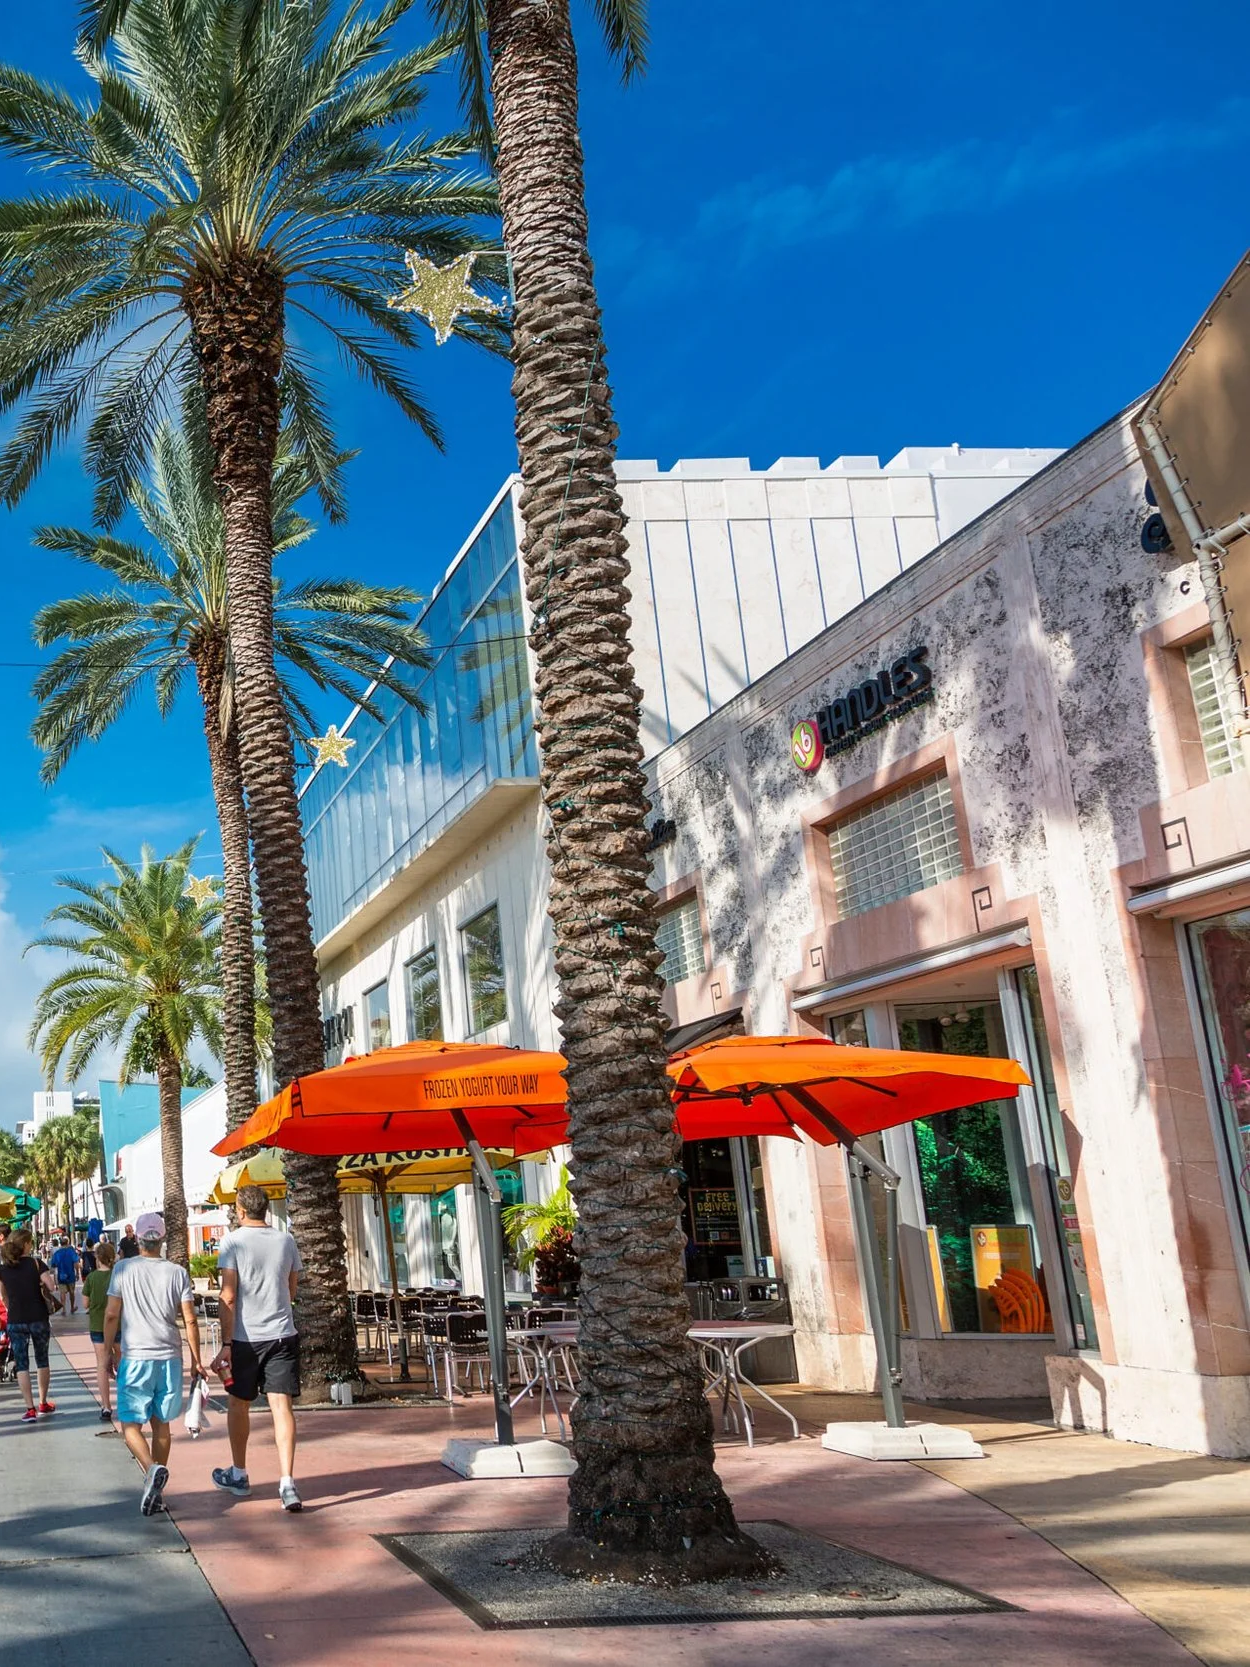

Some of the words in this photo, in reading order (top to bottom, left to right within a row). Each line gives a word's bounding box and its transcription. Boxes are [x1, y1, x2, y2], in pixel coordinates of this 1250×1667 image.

[794, 728, 812, 764] 16
[815, 646, 932, 746] HANDLES
[423, 1079, 458, 1100] FROZEN
[458, 1076, 494, 1097] YOGURT
[495, 1075, 519, 1096] YOUR
[520, 1074, 538, 1094] WAY
